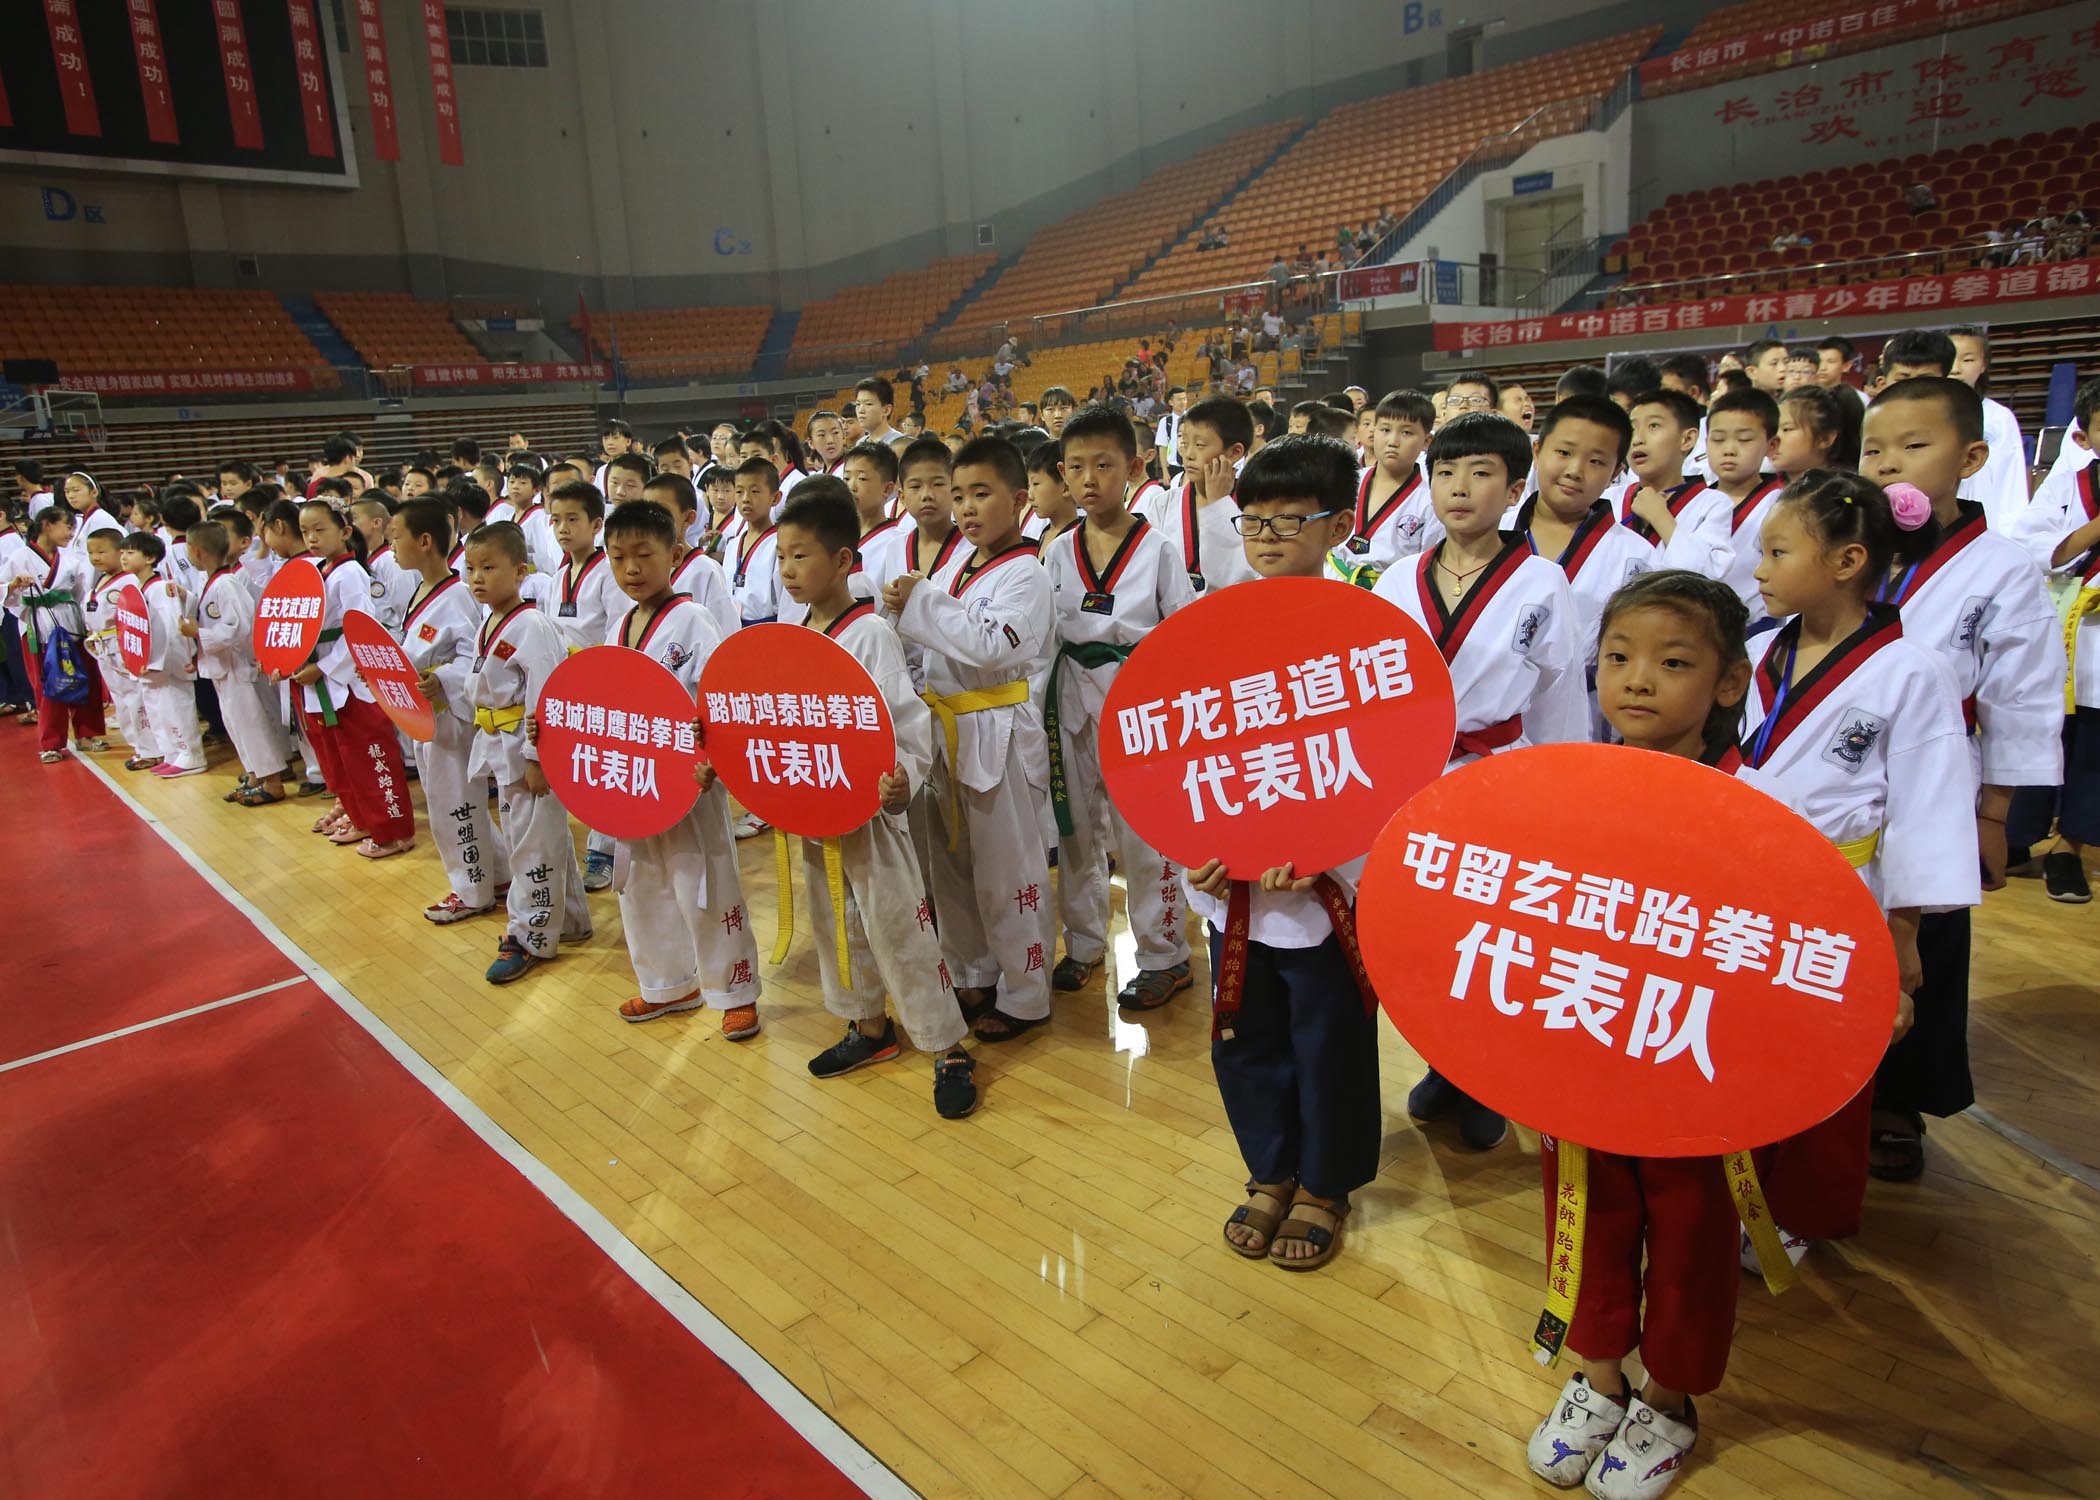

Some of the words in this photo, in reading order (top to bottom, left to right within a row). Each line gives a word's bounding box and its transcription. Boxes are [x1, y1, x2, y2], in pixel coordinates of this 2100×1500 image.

[1459, 320, 1543, 351] 长治市
[259, 597, 322, 619] 壶关龙武道馆
[265, 621, 304, 648] 代表队
[124, 630, 144, 658] 代表队
[376, 678, 421, 711] 代表队
[705, 691, 882, 733] 潞城鸿泰跆拳道
[1118, 637, 1415, 757] 昕龙晟道馆
[545, 698, 697, 755] 黎城博鹰跆拳道
[571, 742, 660, 801] 代表队
[745, 739, 853, 791] 代表队
[1182, 726, 1374, 823] 代表队
[1013, 883, 1045, 975] 博鹰
[1401, 831, 1858, 1004] 屯留玄武跆拳道
[1449, 921, 1716, 1085] 代表队
